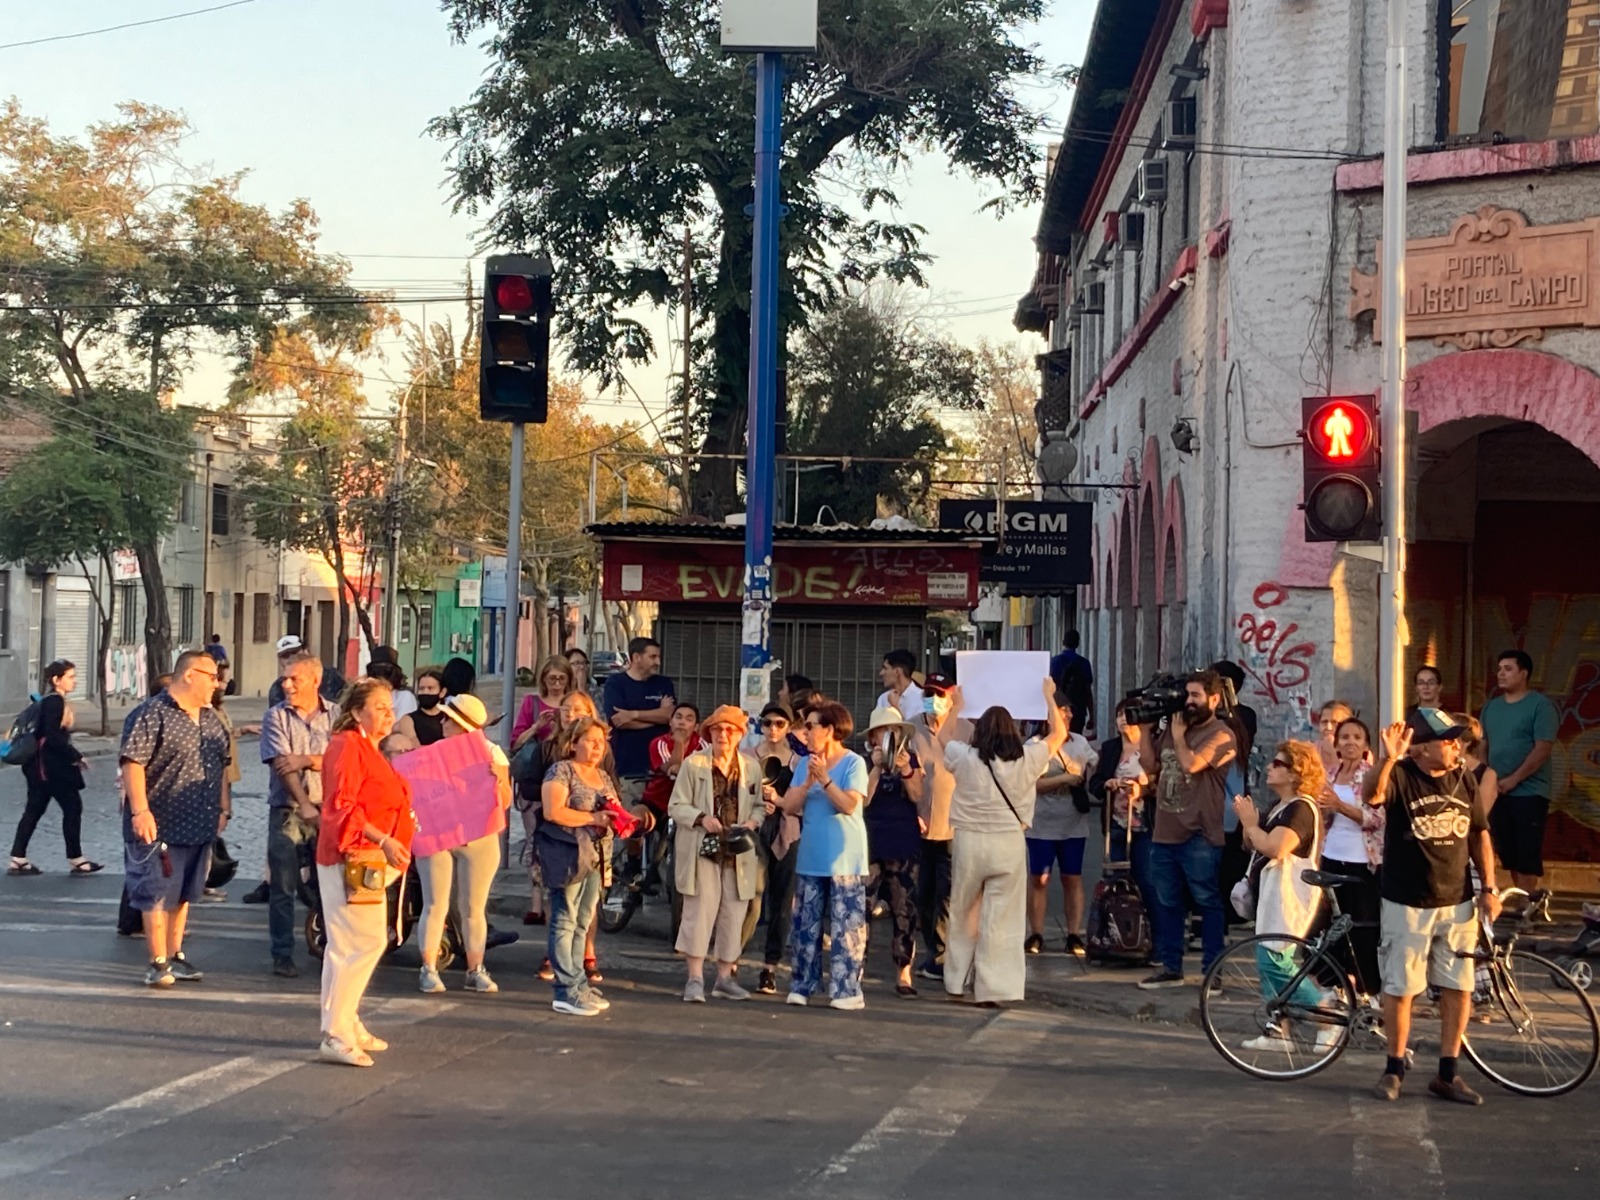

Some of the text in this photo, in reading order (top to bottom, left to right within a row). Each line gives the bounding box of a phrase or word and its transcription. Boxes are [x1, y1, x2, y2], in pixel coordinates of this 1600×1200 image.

[1446, 251, 1523, 281] PORTAL
[1405, 272, 1584, 317] LISEO DEL CAMPO
[986, 511, 1068, 534] RGM
[1024, 543, 1067, 555] Mallas
[992, 564, 1015, 572] Desde
